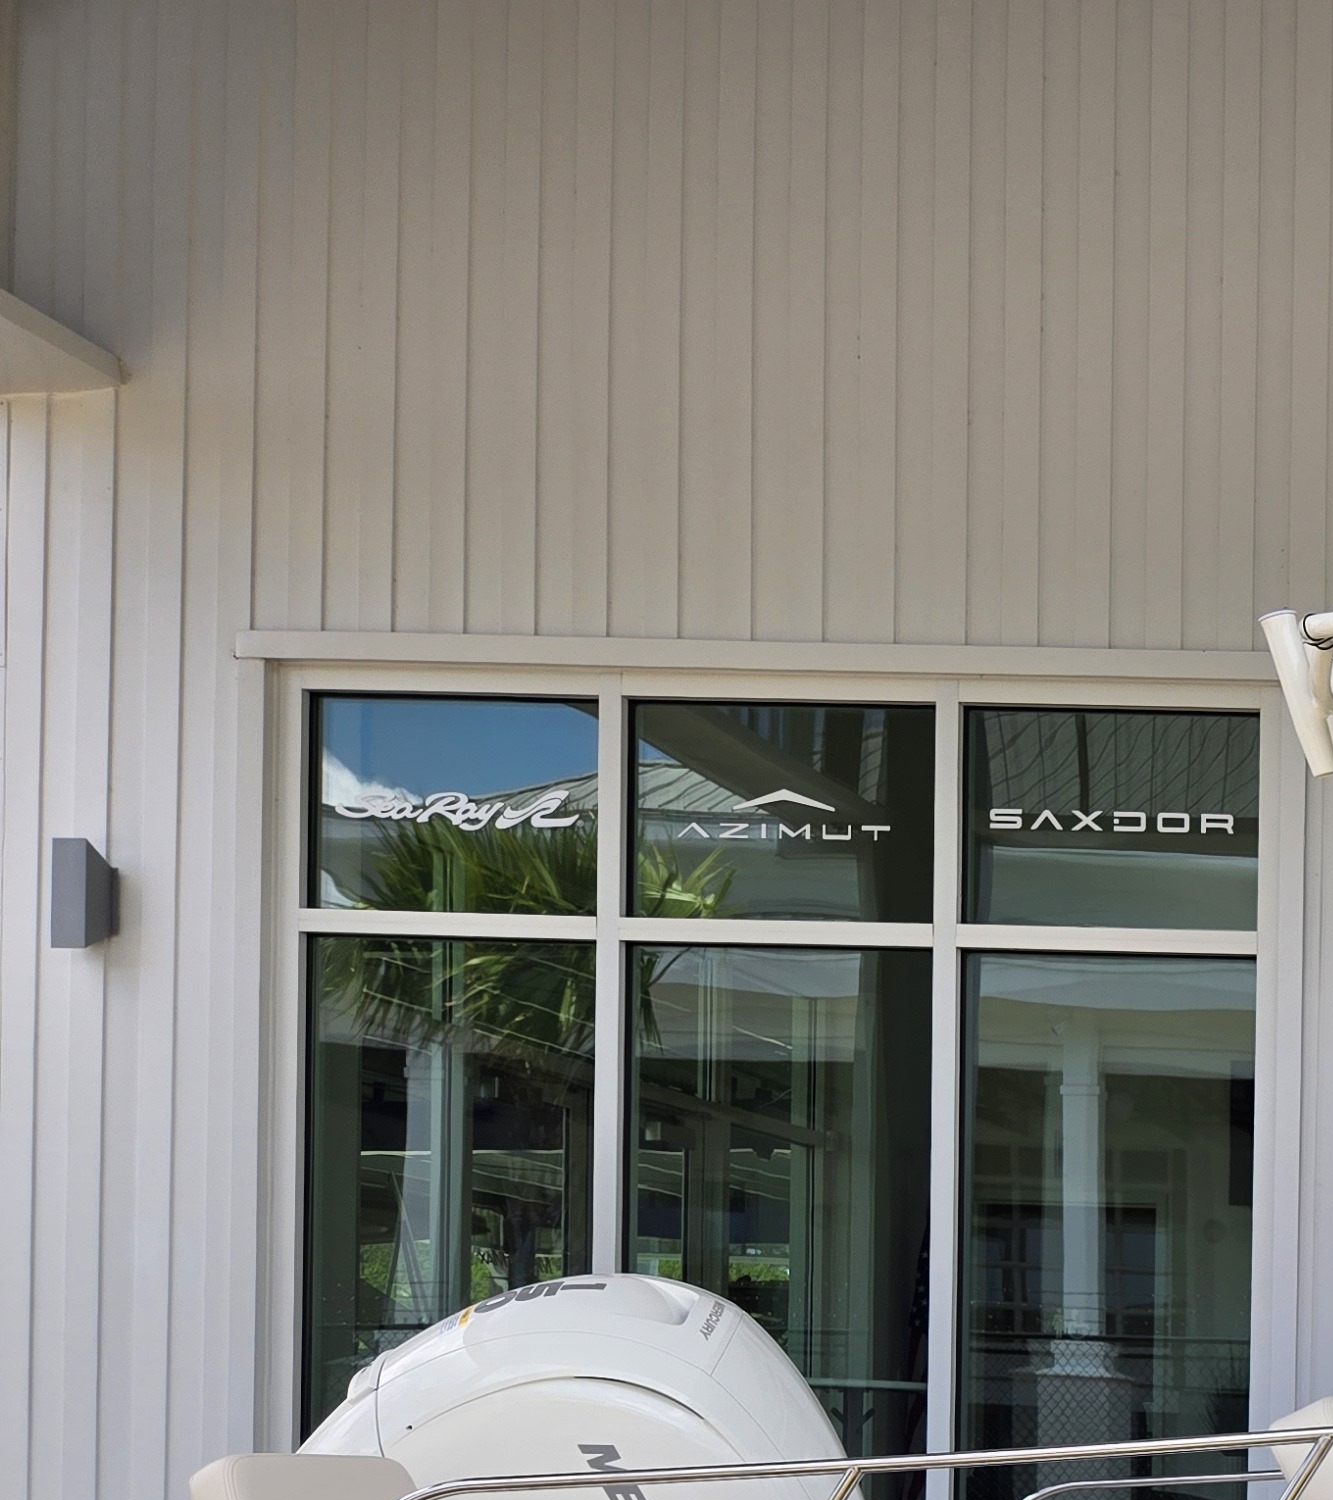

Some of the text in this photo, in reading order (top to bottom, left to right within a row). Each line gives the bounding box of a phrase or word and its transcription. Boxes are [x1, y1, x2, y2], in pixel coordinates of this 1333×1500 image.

[416, 791, 504, 831] Ray
[989, 808, 1234, 835] SAXDOR
[677, 821, 891, 842] AZIMUT
[474, 1281, 607, 1314] 150
[699, 1300, 726, 1341] MERCURY
